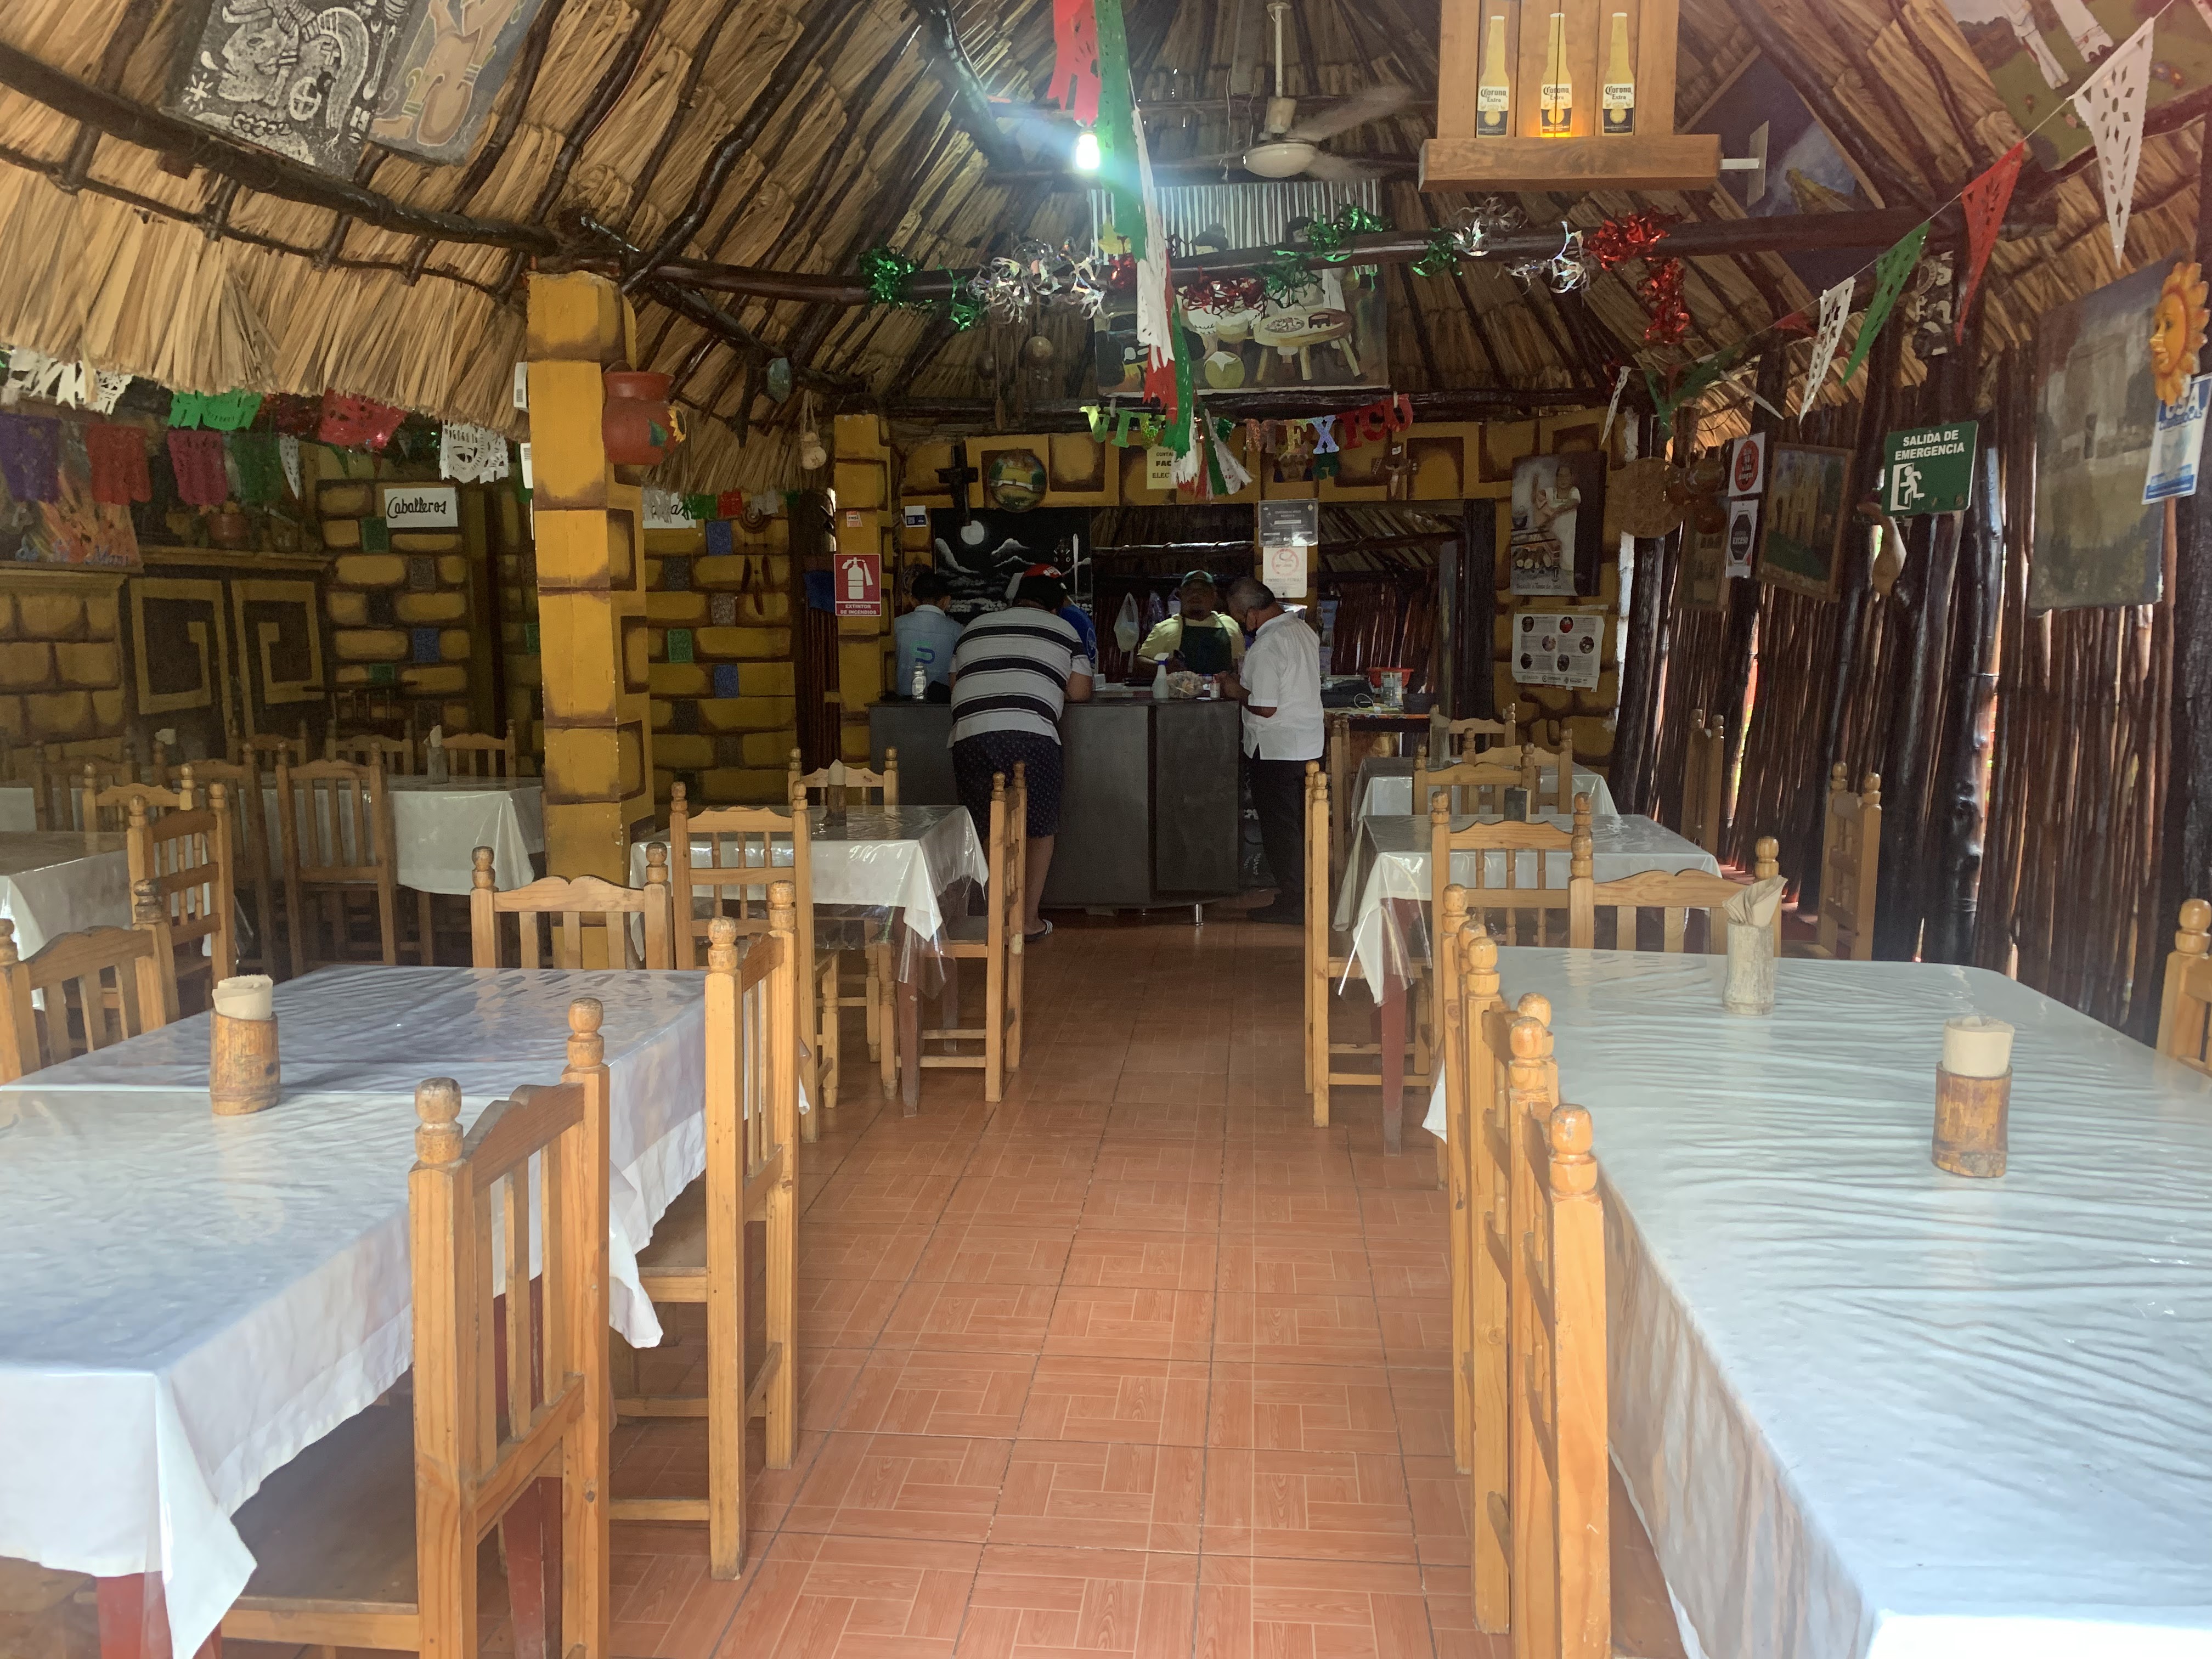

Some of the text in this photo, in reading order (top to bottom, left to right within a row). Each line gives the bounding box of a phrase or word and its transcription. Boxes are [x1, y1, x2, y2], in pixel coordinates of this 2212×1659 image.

[1480, 88, 1508, 98] Corona
[1543, 86, 1570, 96] Corona
[1605, 86, 1633, 96] Corona
[1903, 429, 1959, 447] SALIDA DE
[1894, 442, 1965, 461] EMERGENCIA
[387, 496, 447, 519] Caballeros
